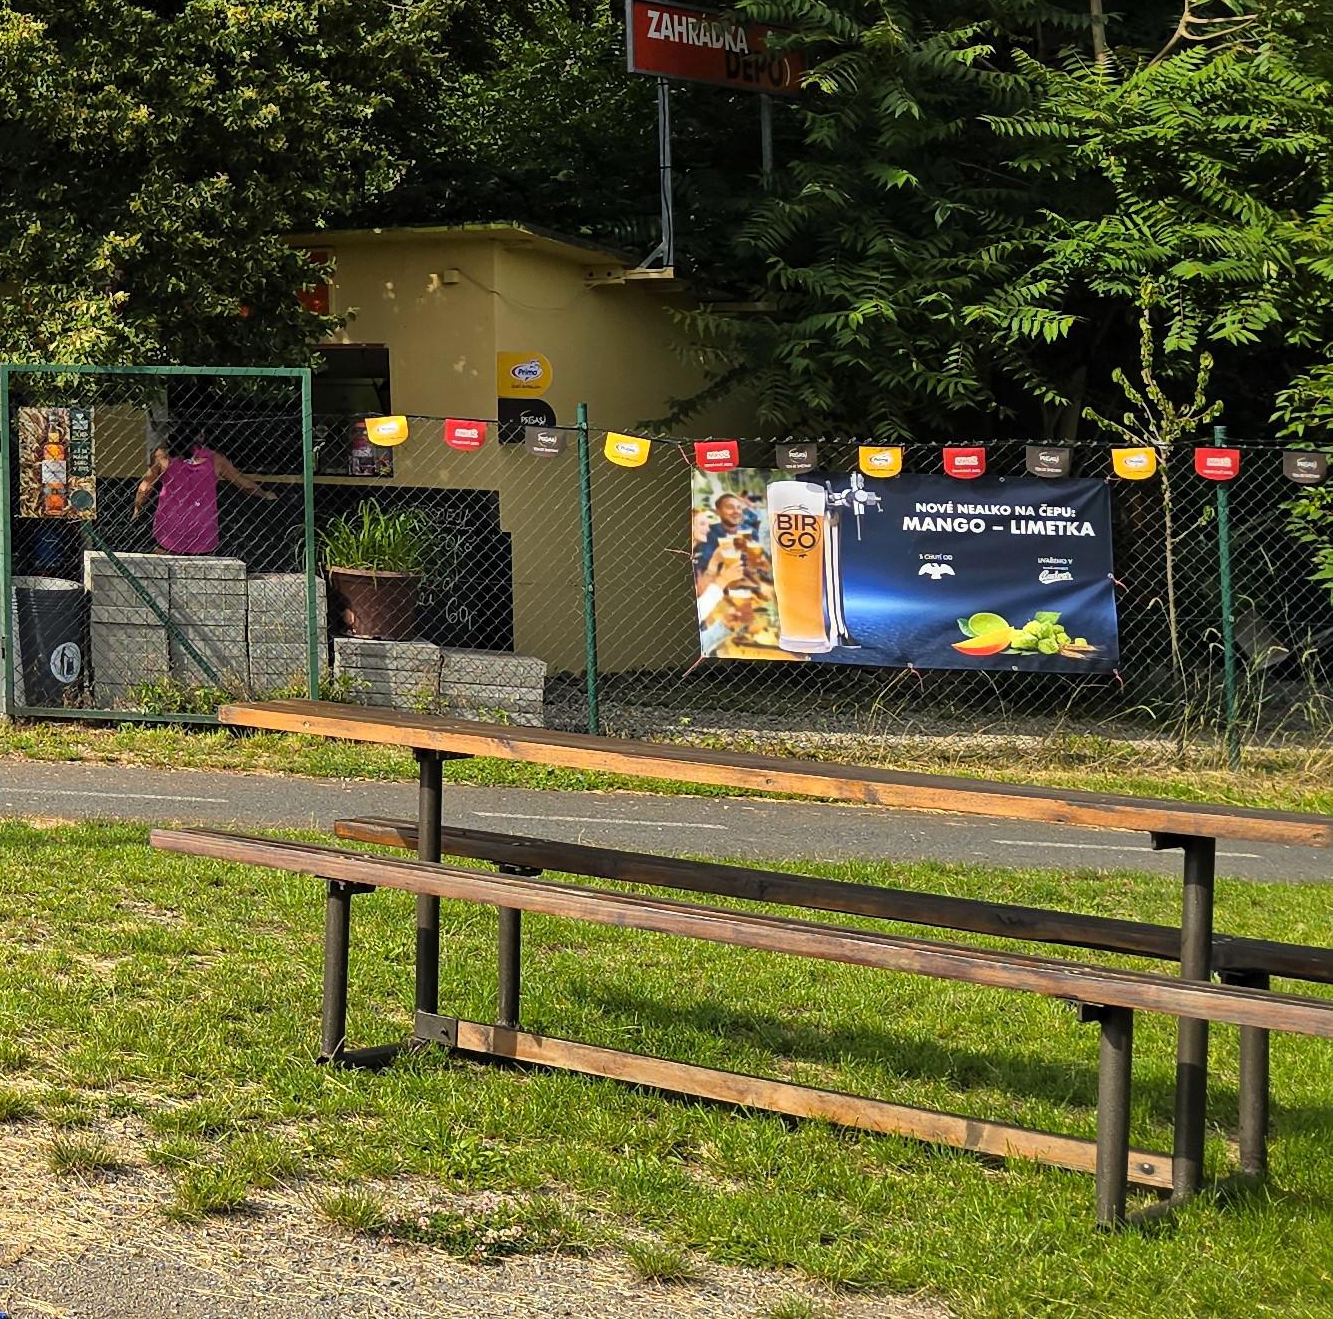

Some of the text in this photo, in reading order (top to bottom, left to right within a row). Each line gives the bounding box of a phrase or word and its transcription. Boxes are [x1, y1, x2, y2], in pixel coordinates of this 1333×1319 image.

[647, 10, 749, 54] ZAHRÁDKA
[915, 501, 1076, 517] NOVÉ NEALKO NA ČEPU:
[777, 514, 817, 531] BIR
[902, 517, 986, 533] MANGO
[1010, 520, 1096, 537] LIMETKA
[778, 532, 816, 549] GO
